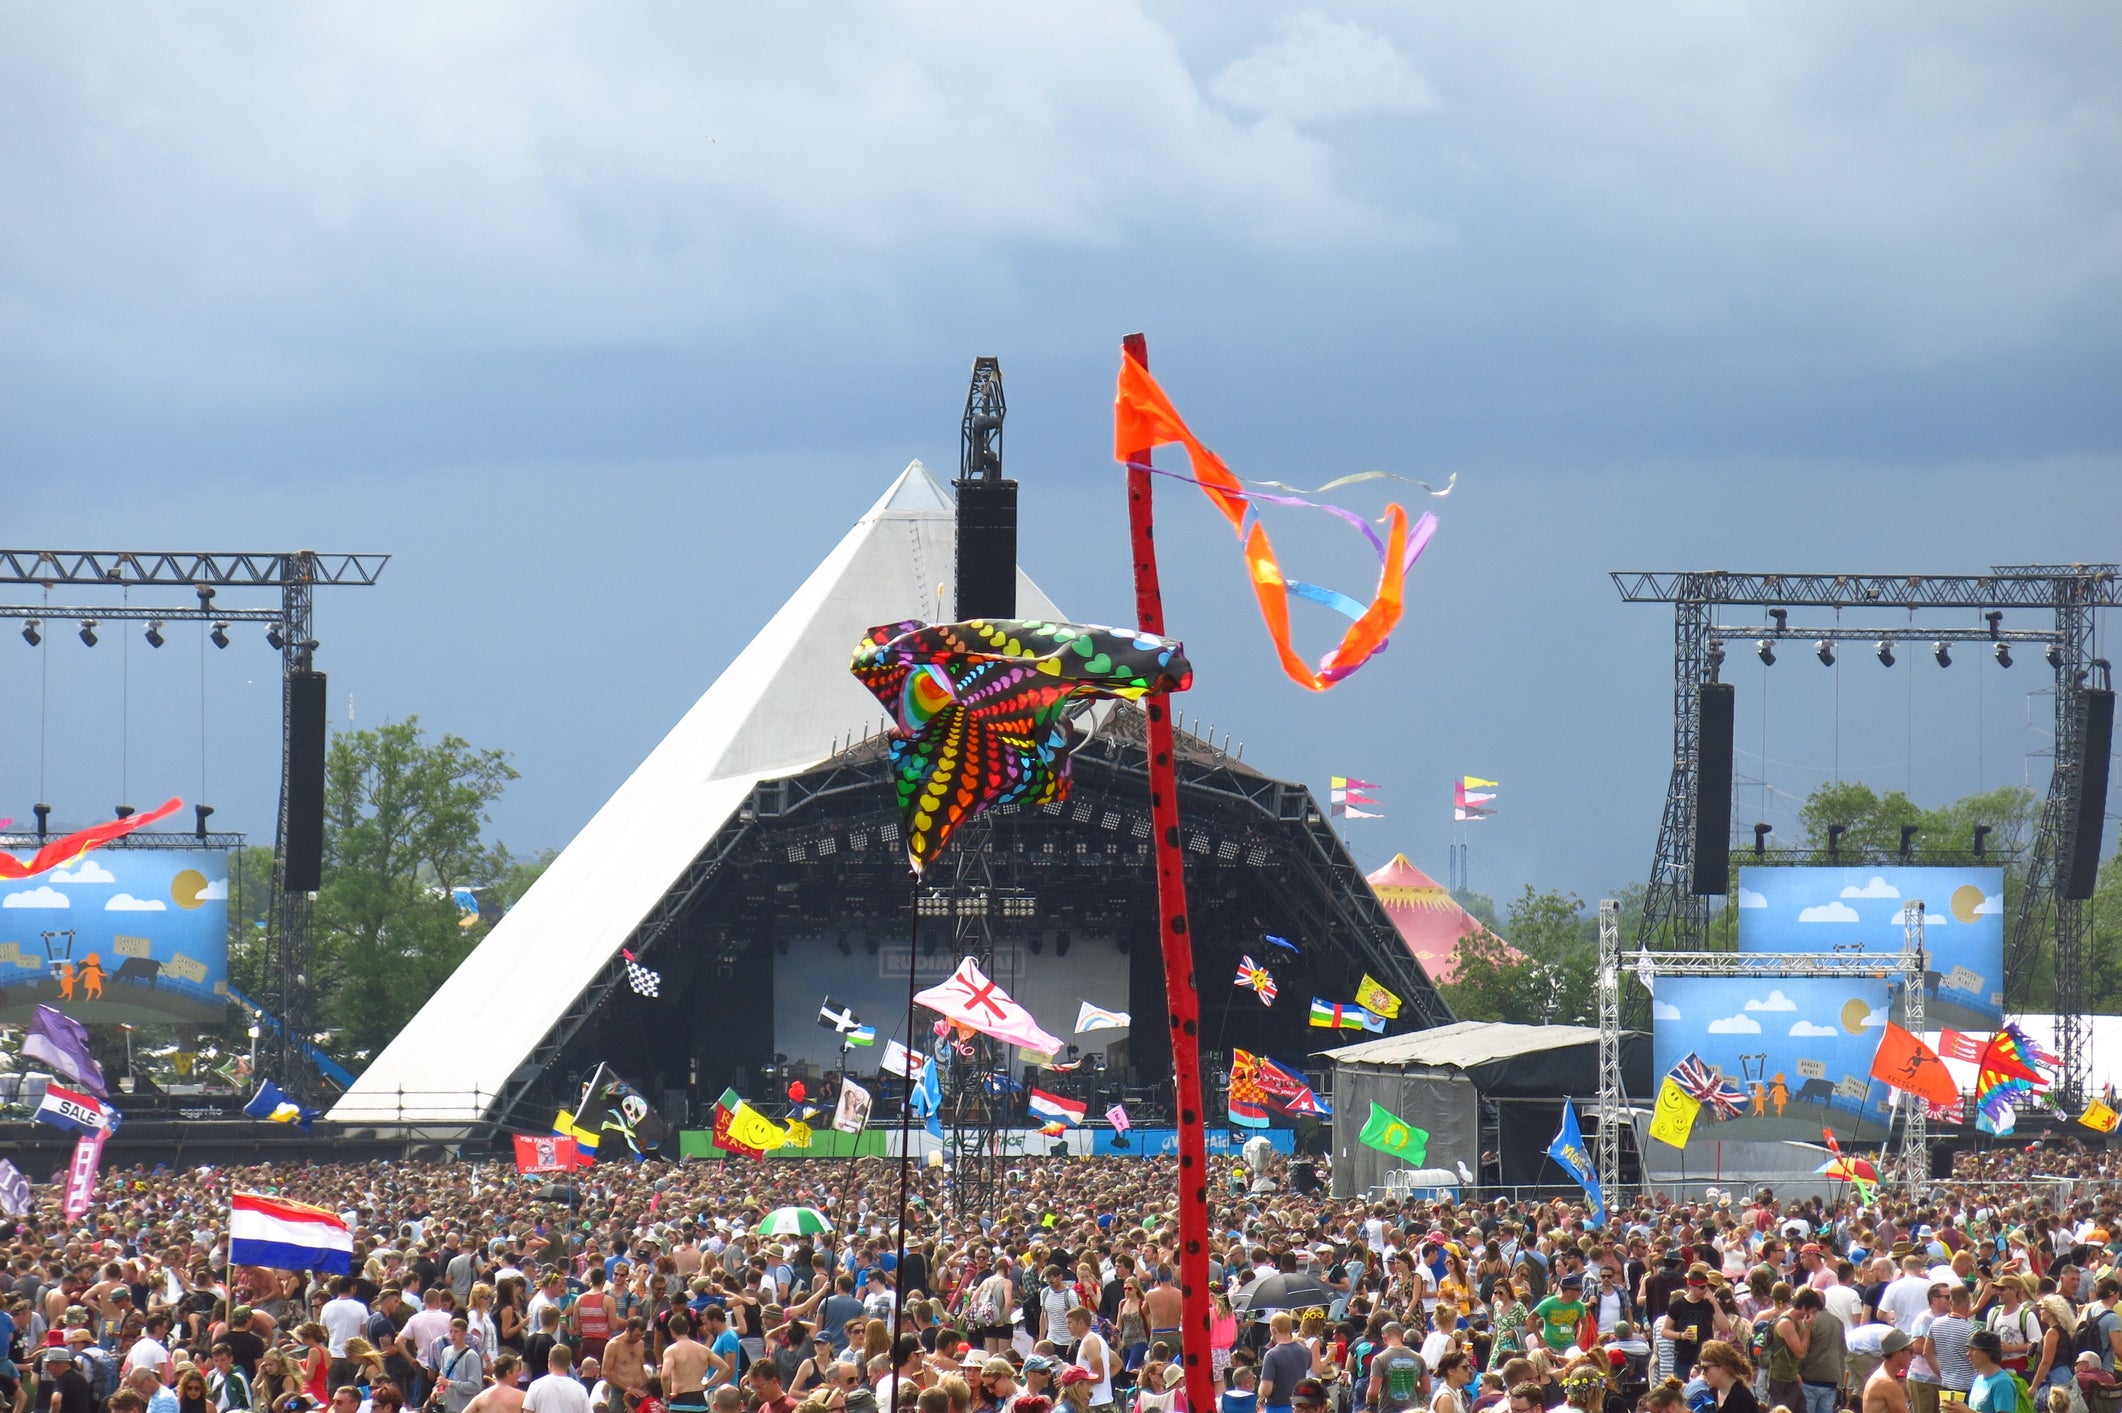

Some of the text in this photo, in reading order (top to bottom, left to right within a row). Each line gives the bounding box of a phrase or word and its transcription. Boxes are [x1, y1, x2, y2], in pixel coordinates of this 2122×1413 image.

[887, 954, 1016, 970] RUDIMAL
[60, 1101, 97, 1125] SALE
[1171, 1135, 1230, 1148] WrAid
